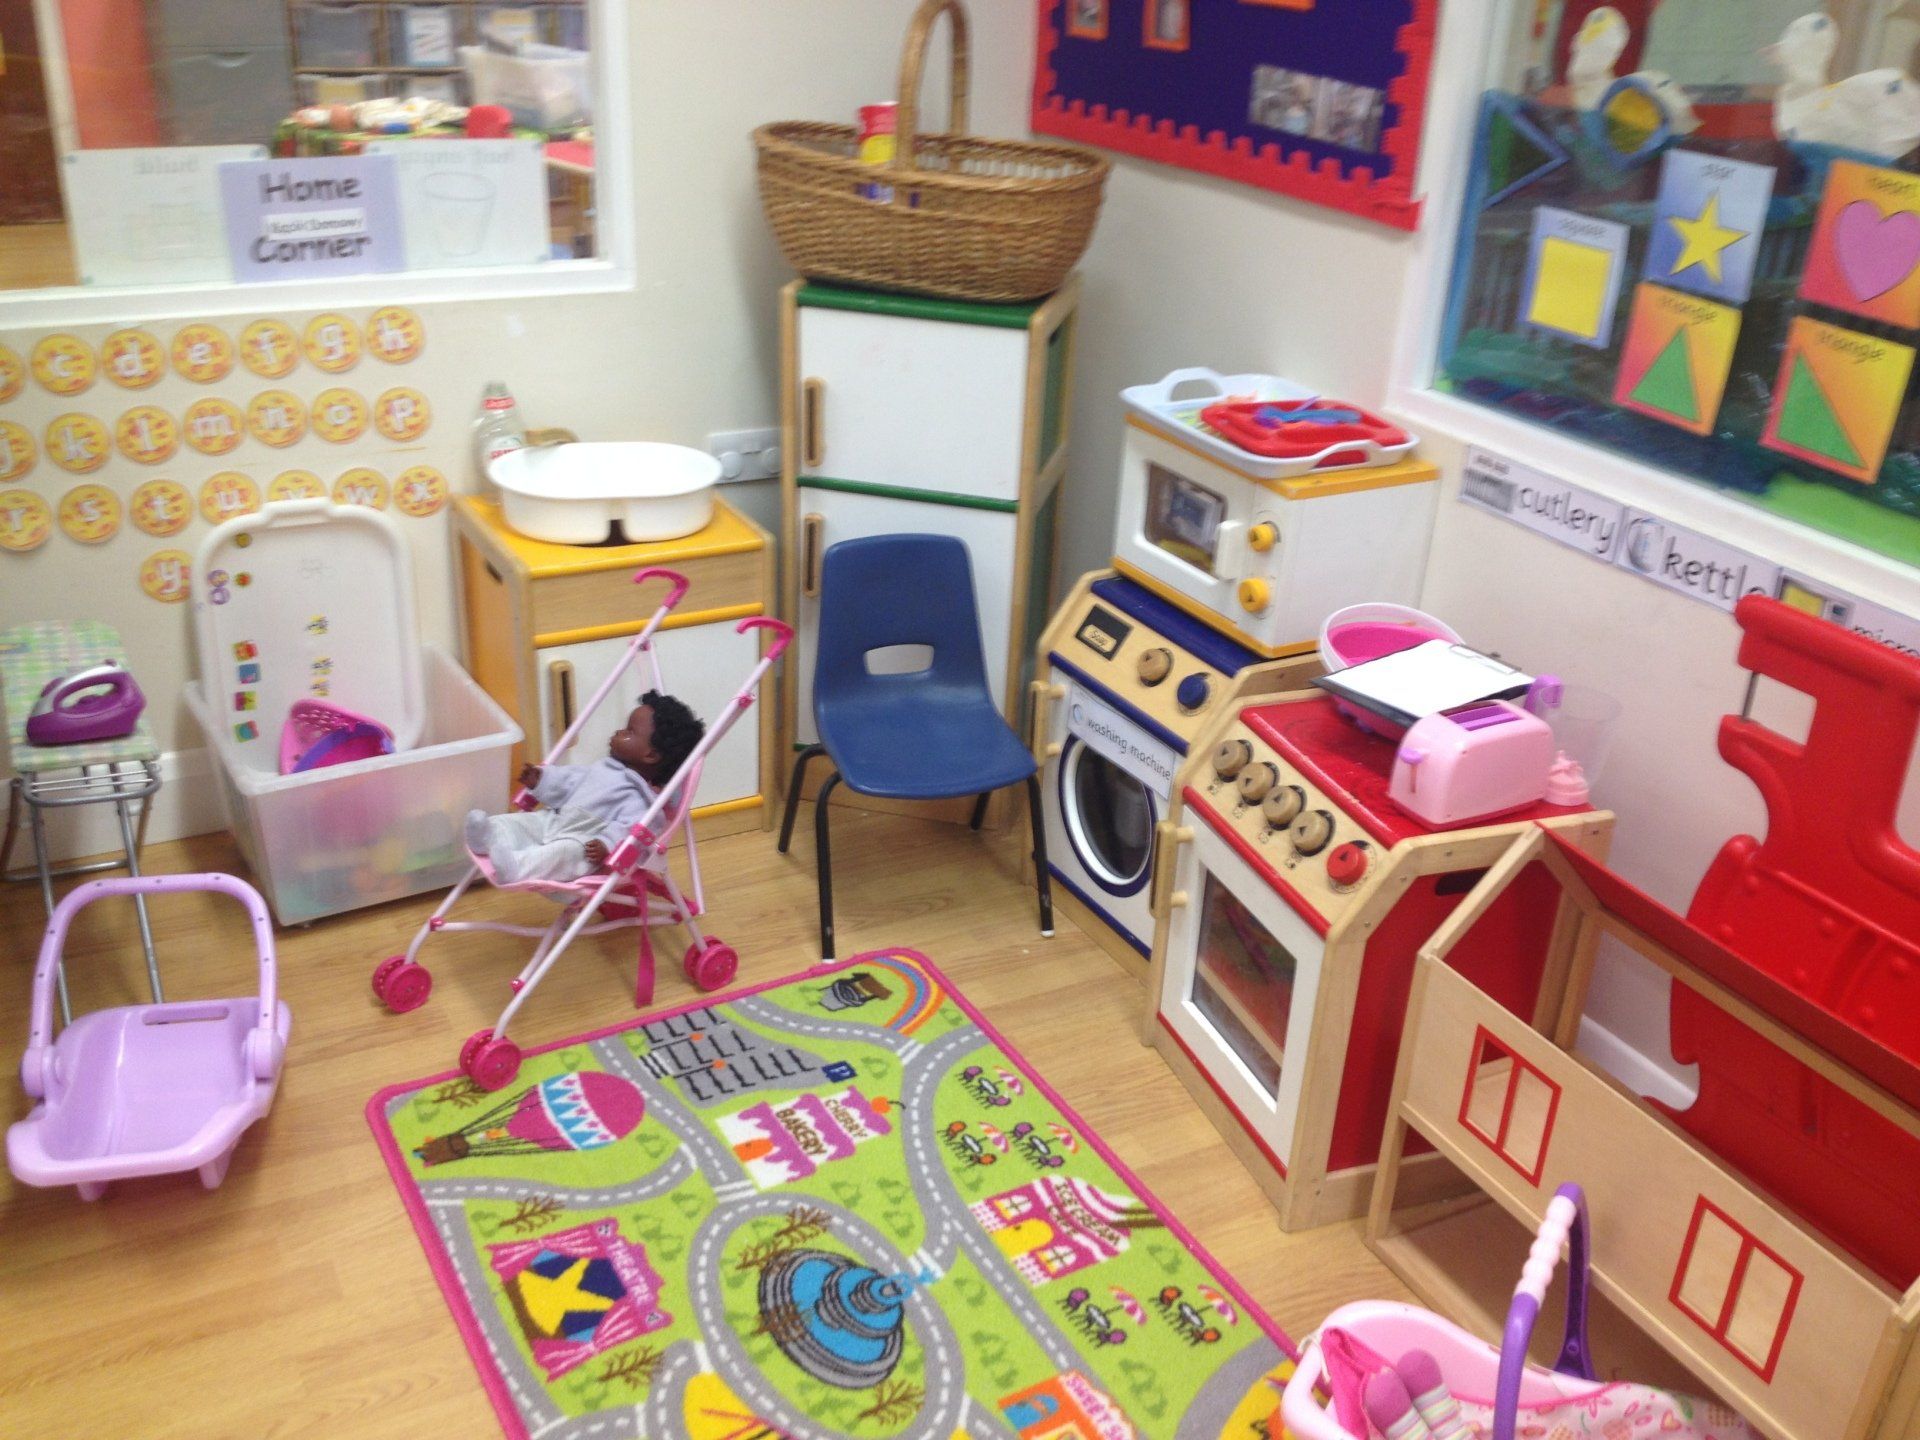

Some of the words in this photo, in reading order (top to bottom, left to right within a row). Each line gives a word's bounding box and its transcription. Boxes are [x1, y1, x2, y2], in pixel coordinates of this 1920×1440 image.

[258, 172, 363, 203] Home
[249, 235, 372, 263] Corner
[113, 340, 146, 378] d
[186, 342, 213, 365] e
[317, 324, 344, 361] g
[60, 425, 95, 462] k
[192, 414, 236, 438] m
[390, 396, 415, 433] p
[1518, 487, 1617, 555] cutlery
[159, 559, 182, 594] y
[1087, 719, 1129, 755] washing
[1129, 744, 1172, 781] machine
[827, 1064, 851, 1078] P
[775, 1108, 828, 1155] BAKERY
[824, 1099, 868, 1138] CHERRY
[1054, 1182, 1078, 1206] ICE
[1070, 1207, 1121, 1246] CREAM
[606, 1239, 653, 1307] THEATRE
[1065, 1375, 1113, 1424] SWEET
